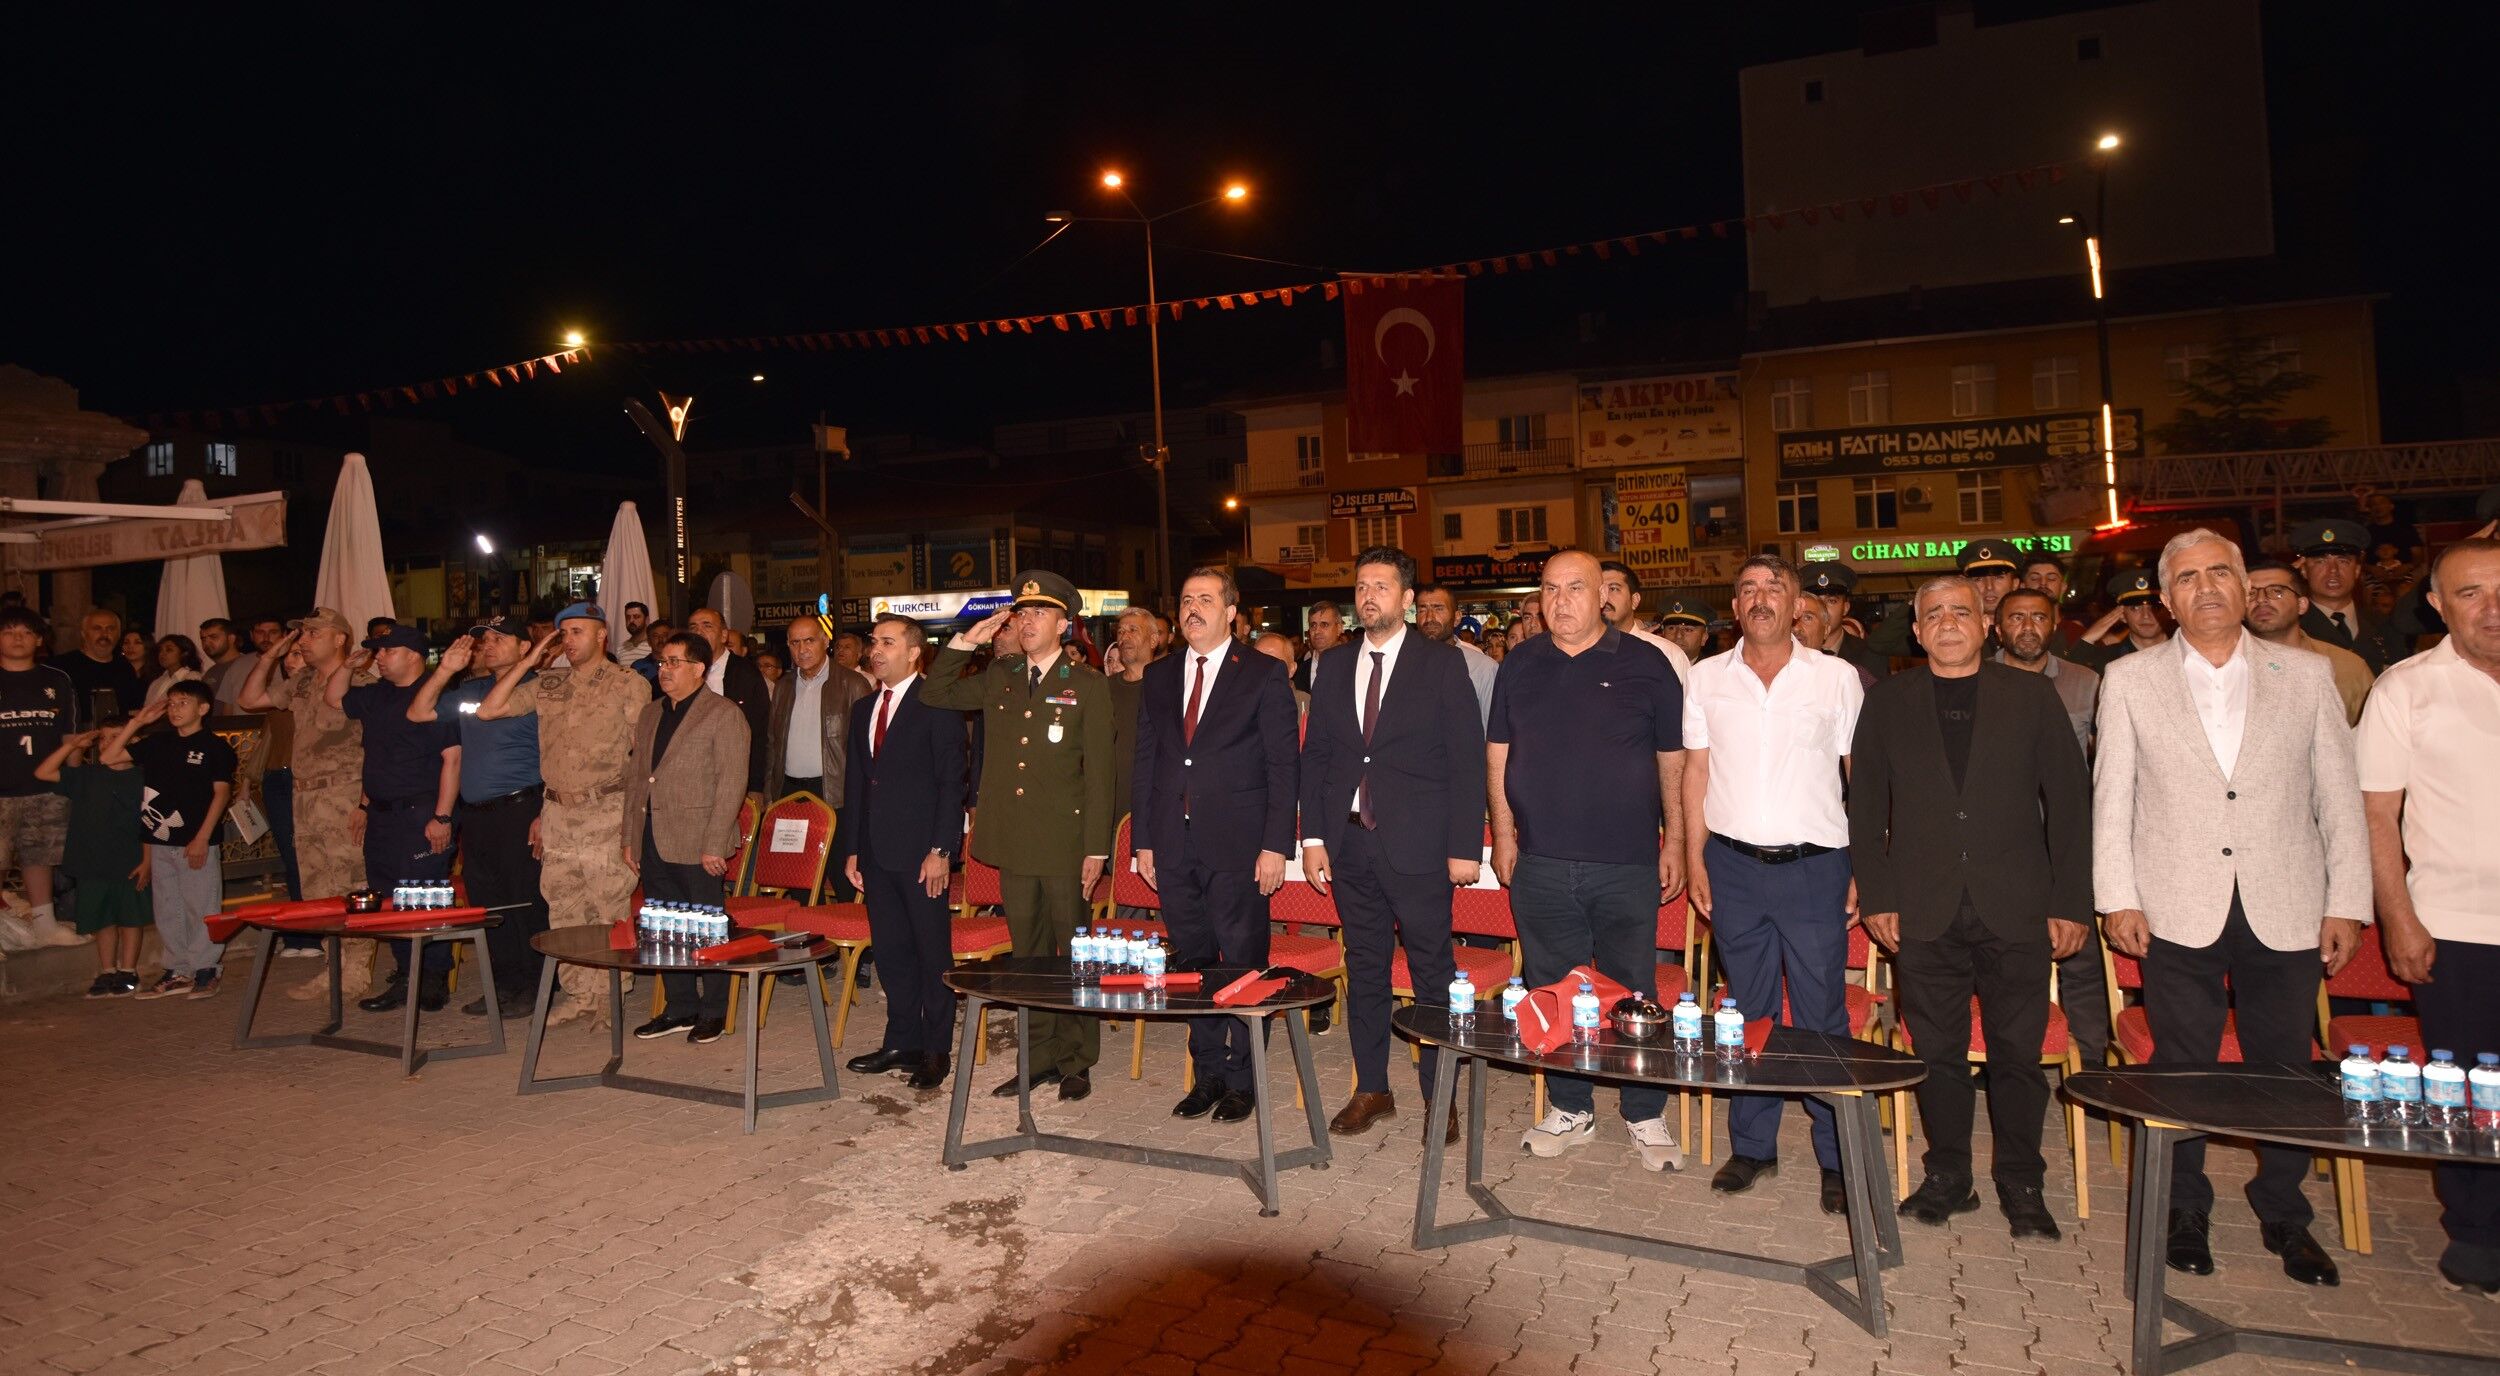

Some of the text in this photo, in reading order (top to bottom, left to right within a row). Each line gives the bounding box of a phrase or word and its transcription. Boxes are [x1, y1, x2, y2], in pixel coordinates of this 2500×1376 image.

[1607, 380, 1710, 409] AKPOL
[1907, 424, 2041, 453] DANIŞMAN
[1883, 450, 1995, 467] 0553 601 85 40
[1618, 471, 1686, 491] BİTİRİYORUZ
[1346, 492, 1375, 506] İŞLER
[676, 497, 684, 549] BELEDİYESİ
[1626, 502, 1680, 527] %40
[1624, 529, 1655, 545] NET
[1623, 545, 1689, 565] İNDİRİM
[1851, 540, 1919, 560] CİHAN
[1436, 562, 1483, 578] BERAT
[757, 602, 803, 618] TEKNİK
[892, 601, 942, 614] TURKCELL
[968, 602, 995, 611] GÖKHAN
[20, 736, 33, 756] 1
